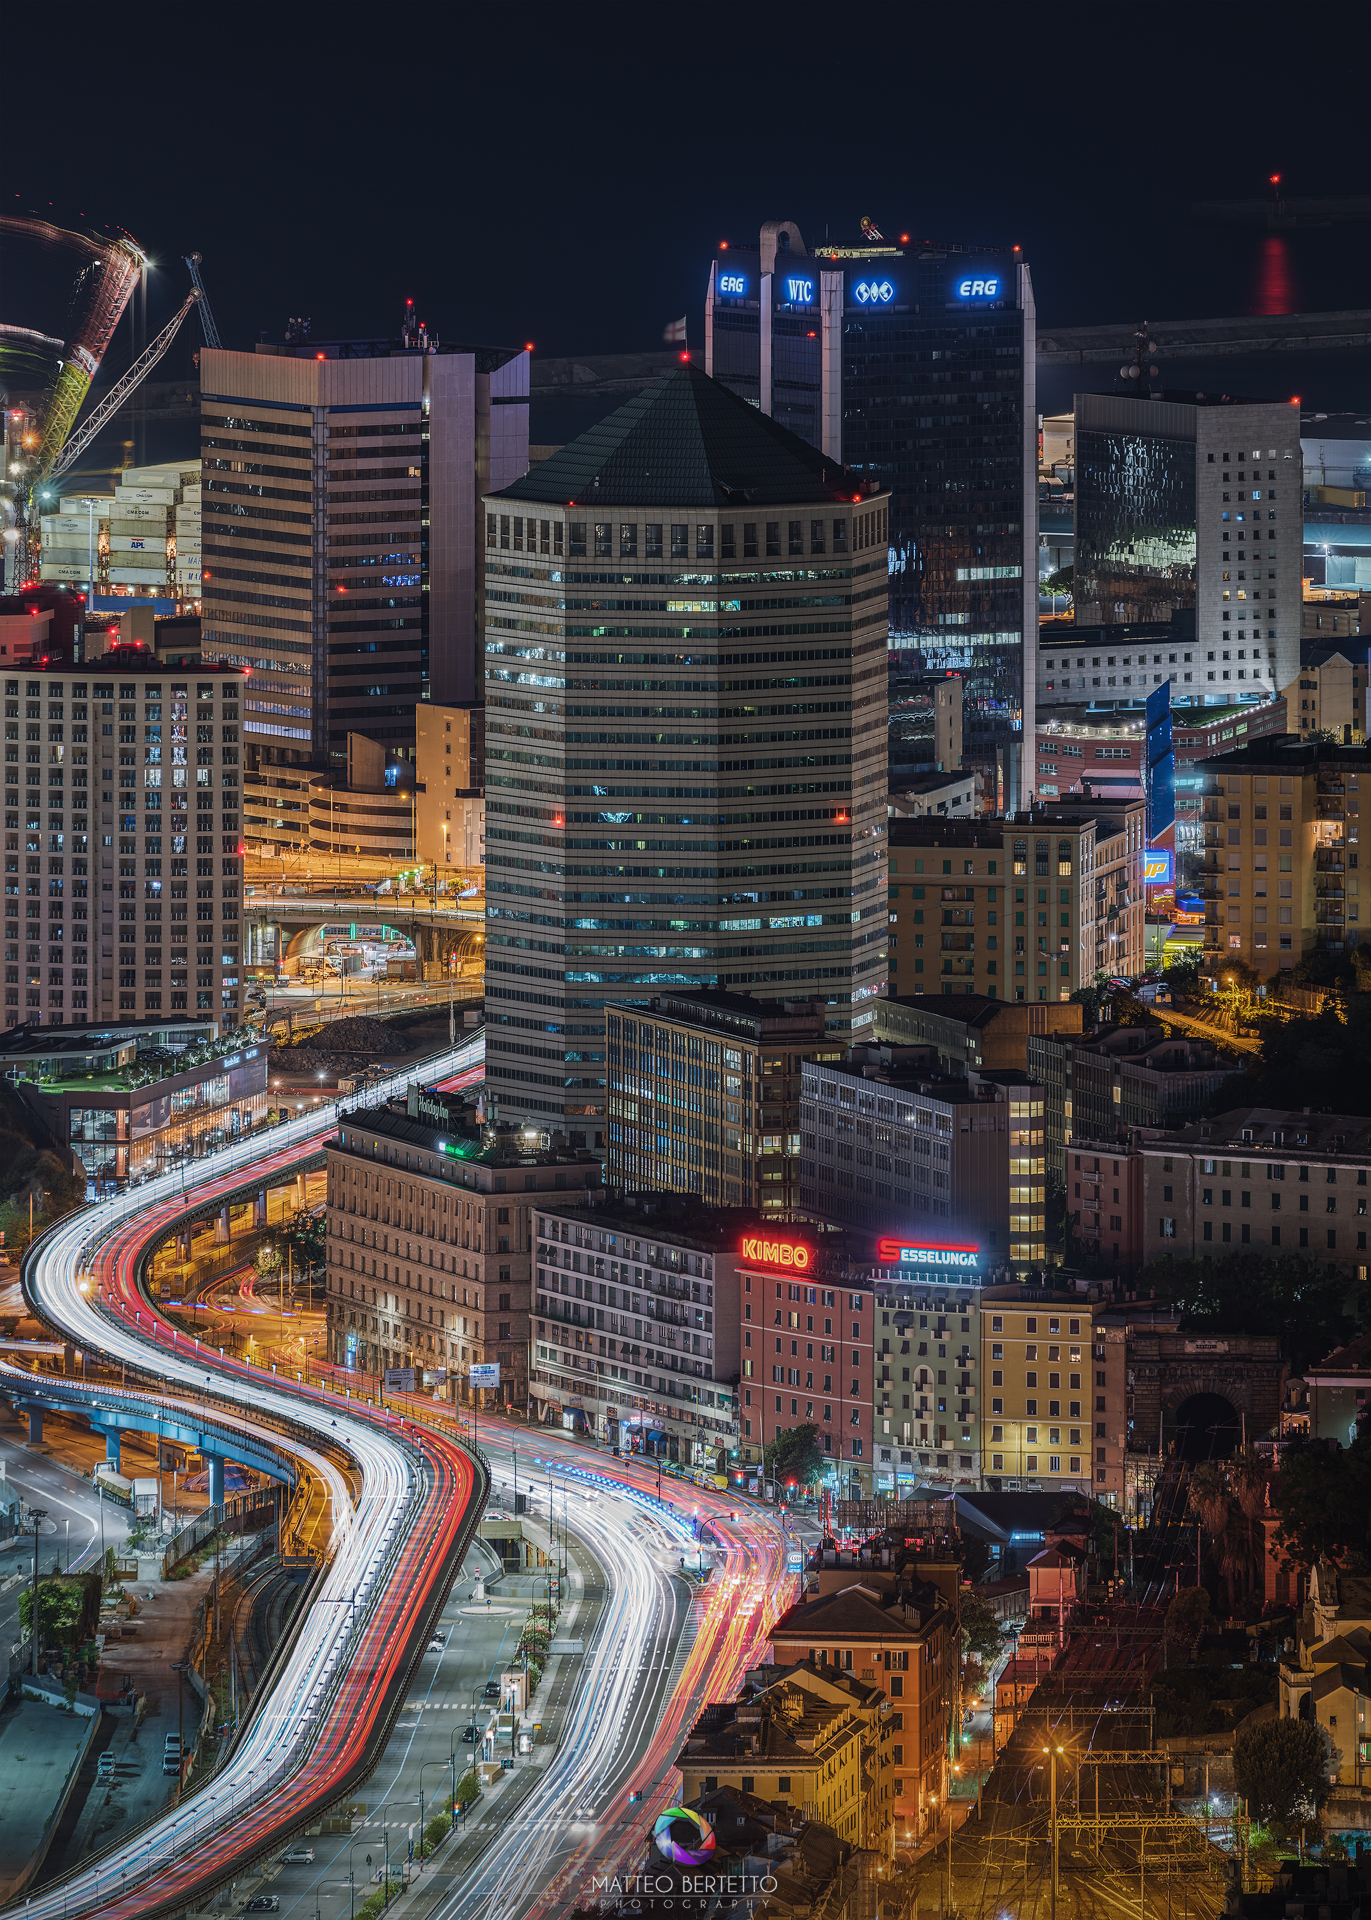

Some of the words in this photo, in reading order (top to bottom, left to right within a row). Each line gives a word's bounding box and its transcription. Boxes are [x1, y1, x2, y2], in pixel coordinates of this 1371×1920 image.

[721, 276, 744, 293] ERG
[788, 279, 811, 302] WTC
[959, 279, 997, 296] ERG
[131, 541, 145, 549] APL
[418, 1095, 439, 1120] Holiday
[742, 1238, 808, 1268] KIMBO
